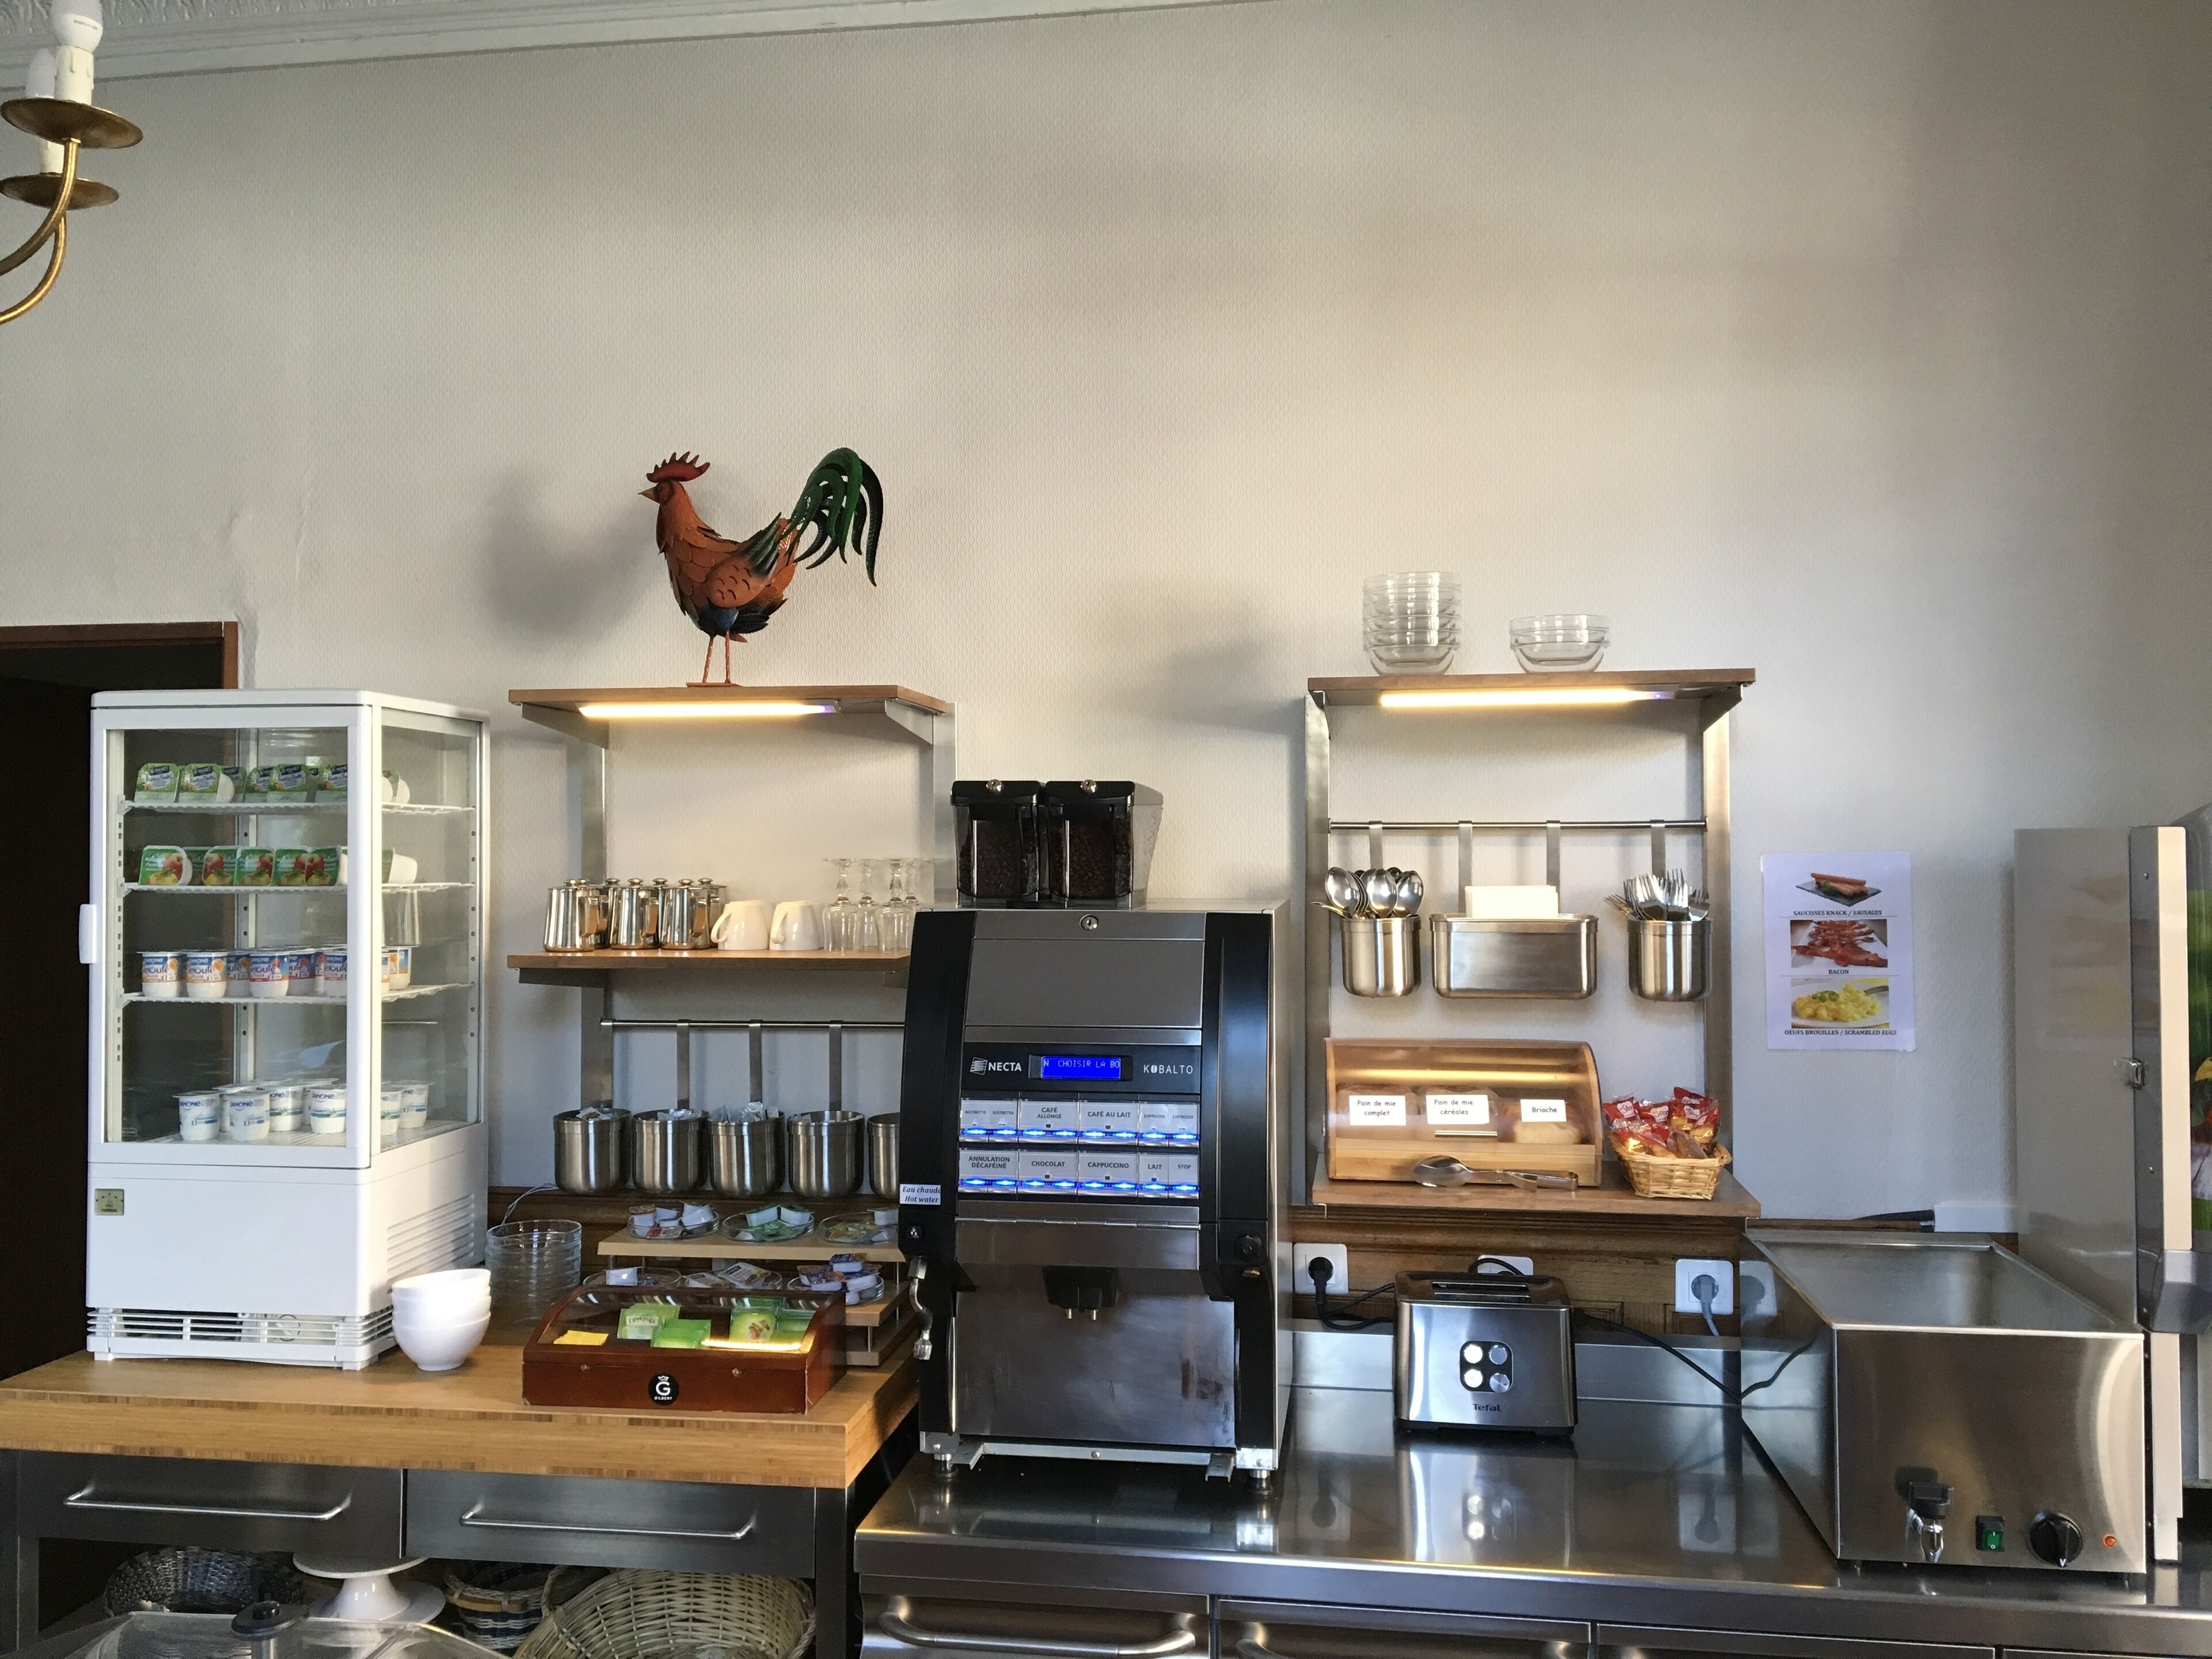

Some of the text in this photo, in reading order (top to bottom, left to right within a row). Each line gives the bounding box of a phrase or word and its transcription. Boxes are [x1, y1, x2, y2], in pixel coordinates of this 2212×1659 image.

[988, 1062, 1022, 1071] NECTA
[1143, 1065, 1193, 1074] KOBALTO
[1364, 1109, 1389, 1118] complet
[656, 1381, 671, 1396] G
[1472, 1403, 1502, 1412] Tefal
